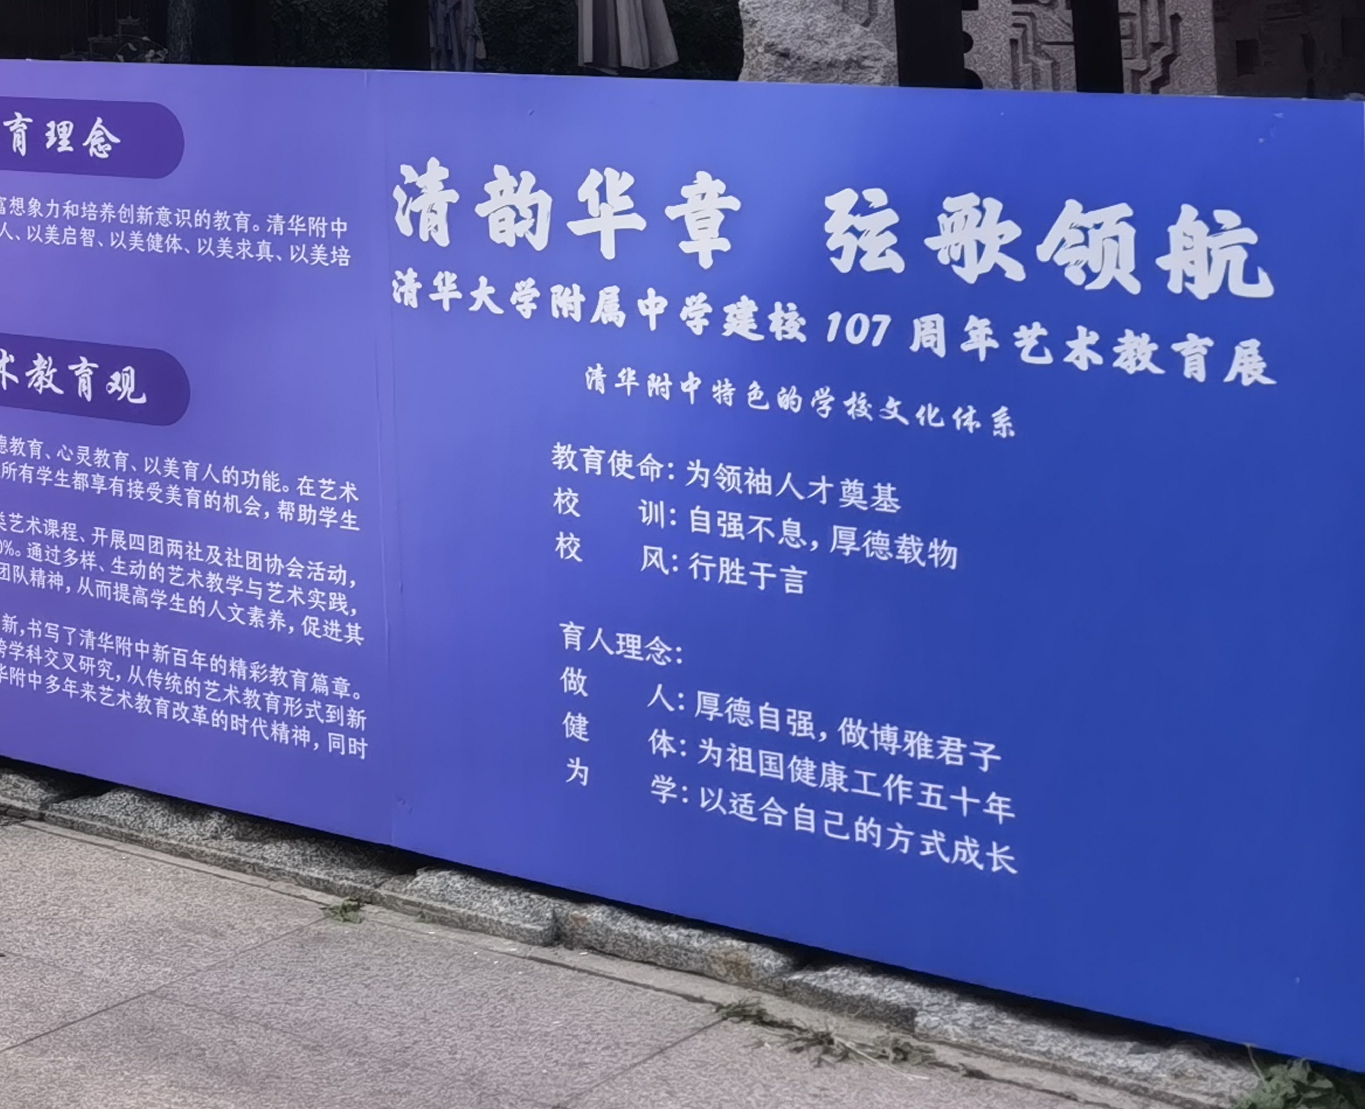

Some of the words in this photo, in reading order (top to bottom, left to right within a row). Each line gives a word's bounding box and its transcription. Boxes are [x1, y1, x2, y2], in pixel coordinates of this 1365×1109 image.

[393, 157, 741, 269] 清韵华章
[824, 188, 1274, 300] 弦歌领航
[392, 268, 807, 343] 清华大学附属中学建校
[825, 310, 892, 347] 107
[909, 313, 1276, 386] 周年艺术教育展
[585, 363, 1016, 439] 清华附中特色的学校文化体系
[552, 442, 901, 513] 教育使命：为领袖人才奠基
[553, 487, 581, 518] 校
[555, 531, 583, 562] 校
[640, 545, 809, 595] 风：行胜于言
[559, 621, 684, 666] 育人理念：
[559, 667, 589, 698] 做
[562, 712, 590, 742] 健
[565, 757, 589, 787] 为
